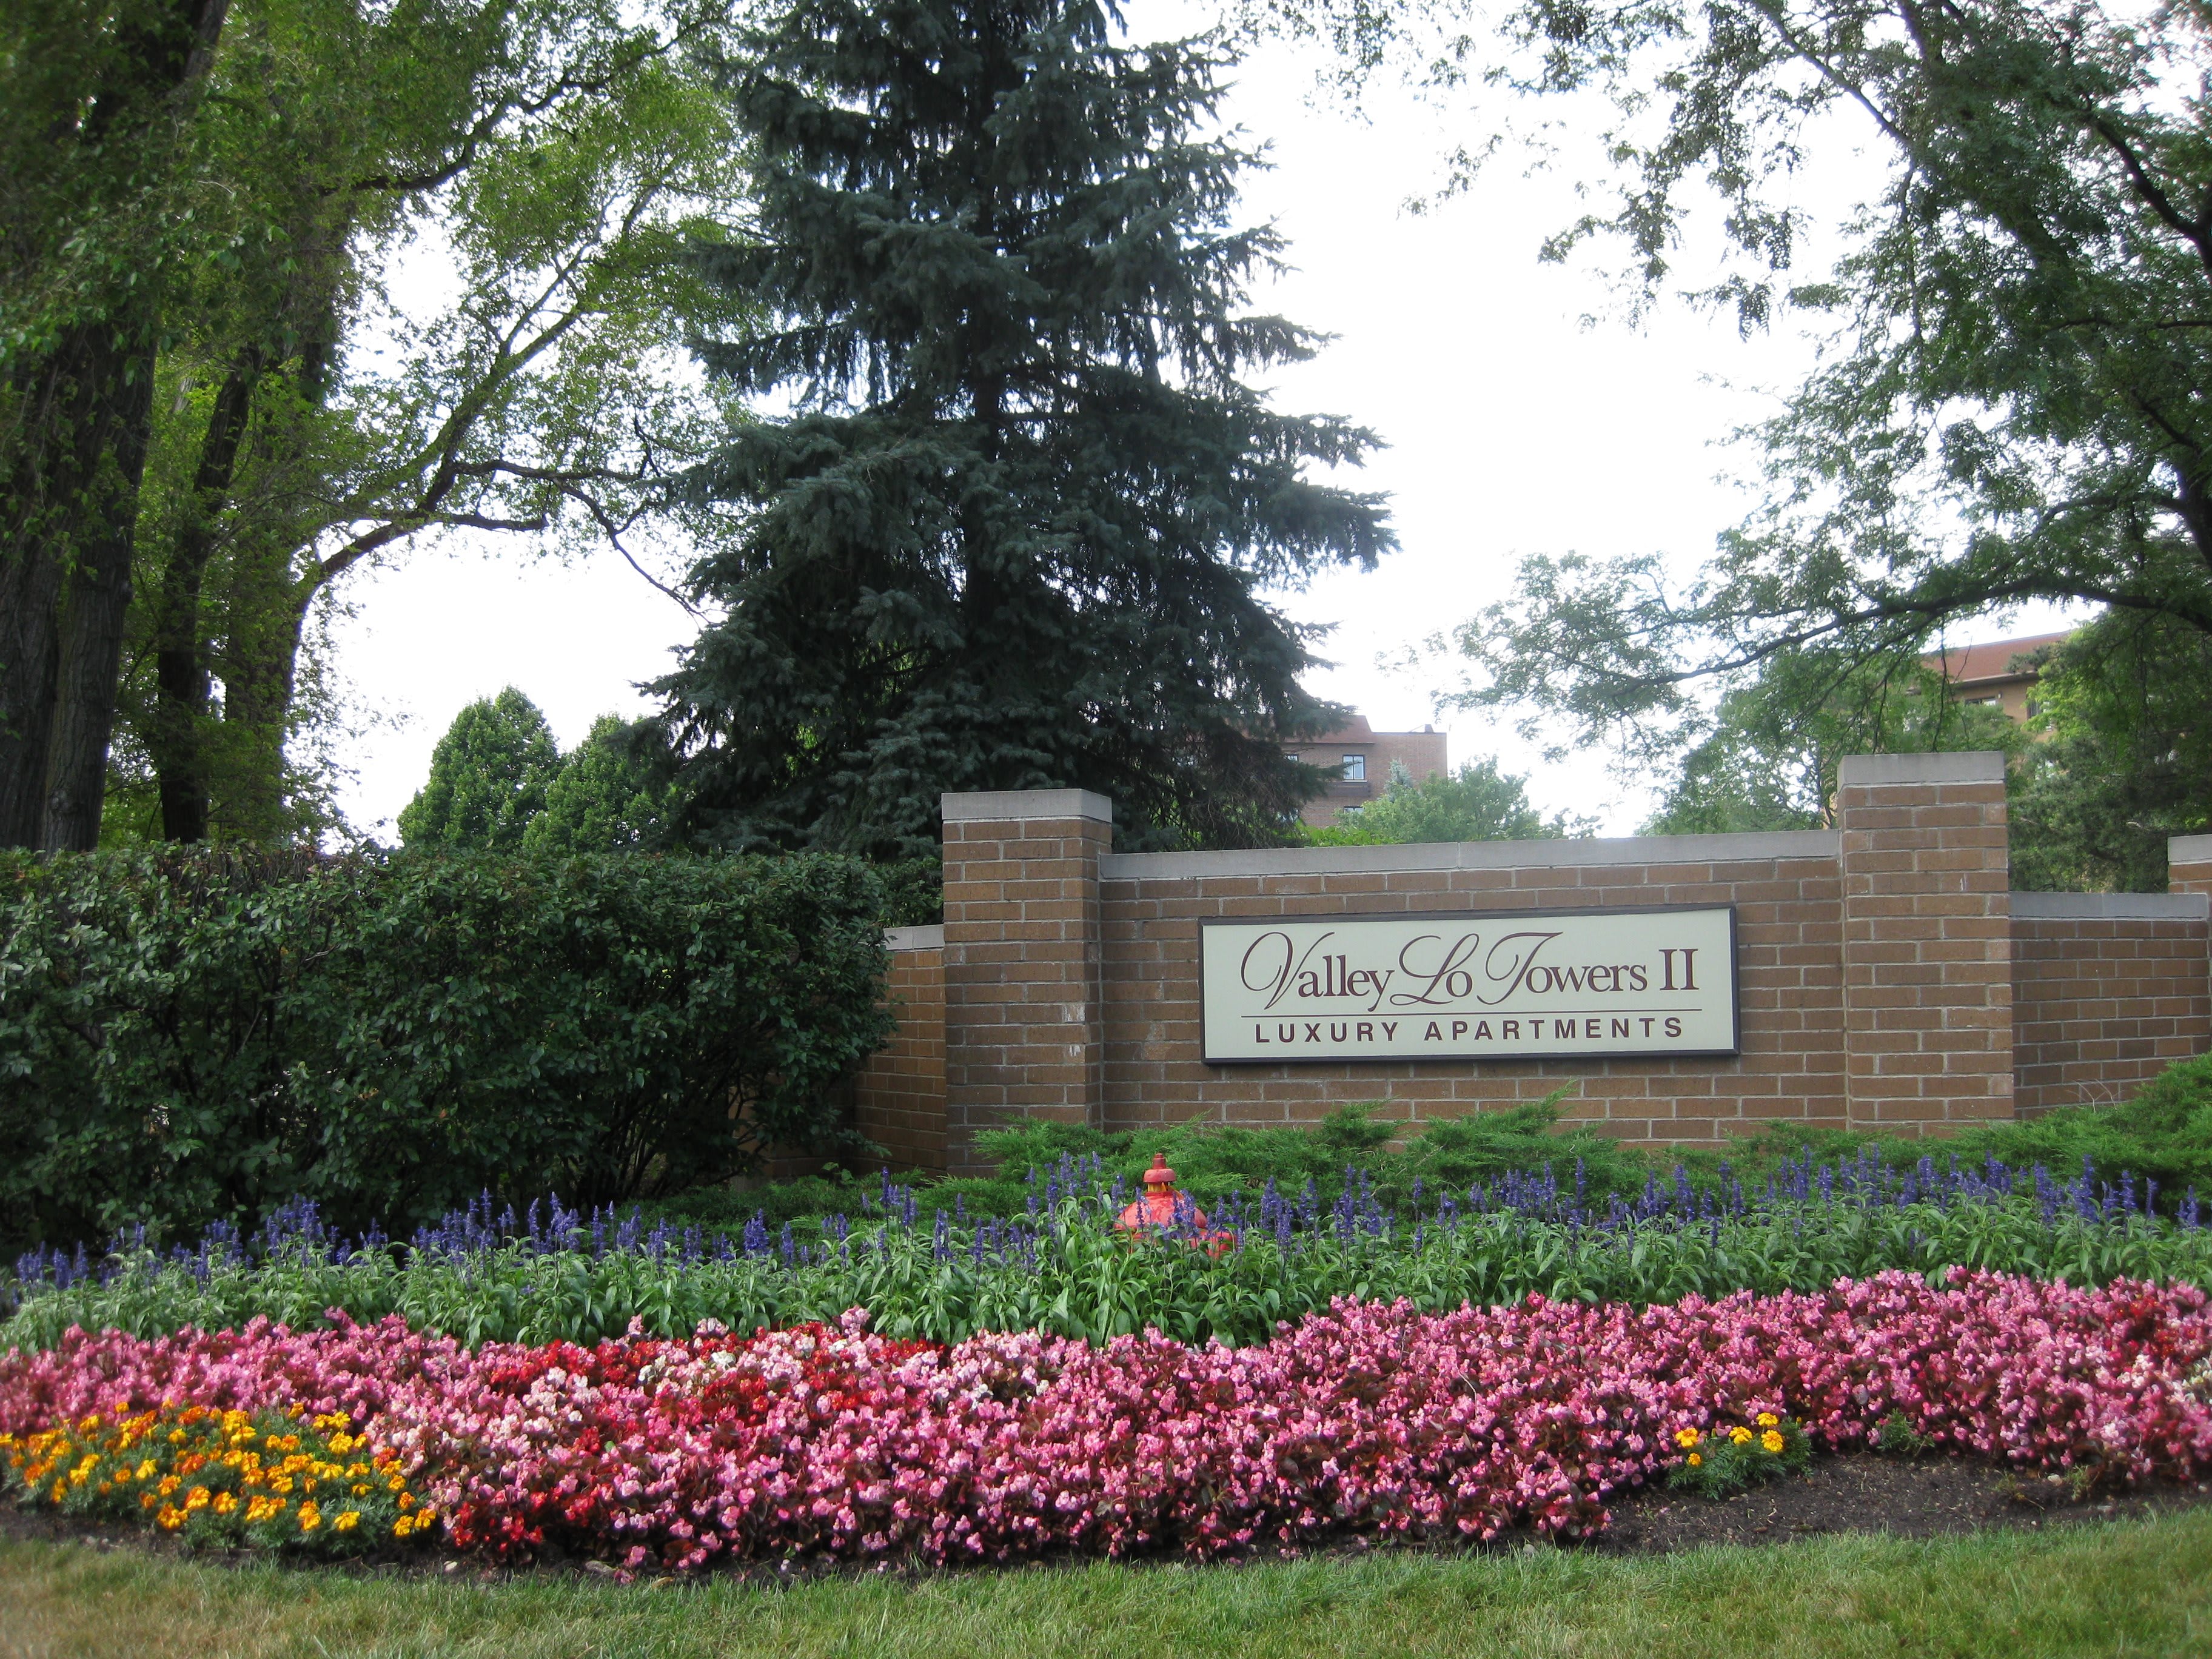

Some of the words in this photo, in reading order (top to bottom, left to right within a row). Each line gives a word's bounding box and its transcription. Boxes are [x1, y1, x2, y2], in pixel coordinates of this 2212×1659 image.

[1240, 931, 1396, 1013] Valley
[1389, 932, 1480, 1007] Lo
[1476, 931, 1649, 1006] Towers
[1658, 948, 1700, 991] II
[1255, 1021, 1399, 1044] LUXURY
[1423, 1016, 1683, 1042] APARTMENTS
